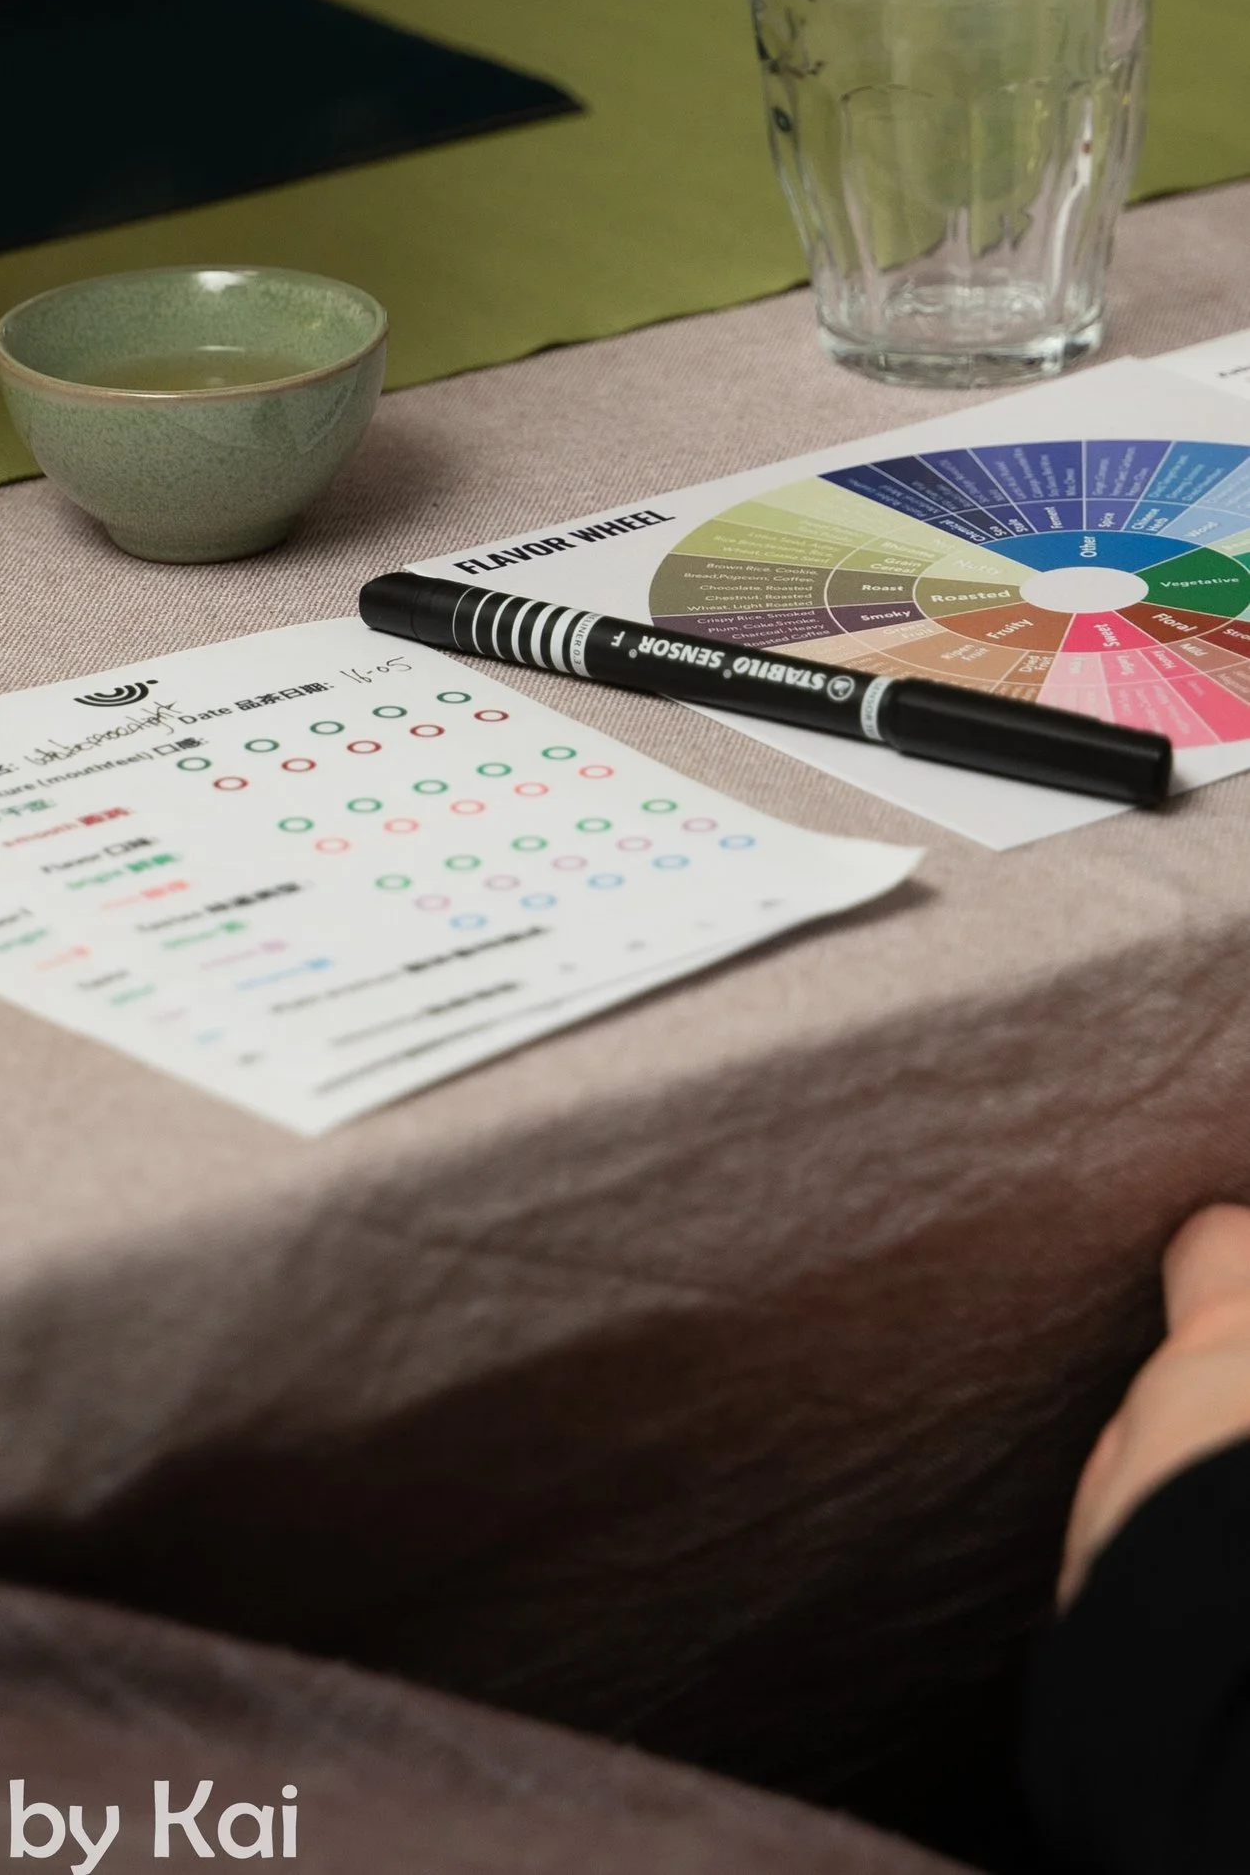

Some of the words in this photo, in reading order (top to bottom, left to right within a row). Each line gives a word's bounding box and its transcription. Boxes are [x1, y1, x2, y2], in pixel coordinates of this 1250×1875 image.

[452, 536, 578, 575] FLAVOR
[567, 509, 676, 543] WHEEL
[1079, 536, 1097, 558] Other
[706, 563, 743, 571] Brown
[870, 563, 916, 574] Cereal
[884, 557, 923, 568] Grain
[765, 584, 813, 592] Roasted
[861, 584, 905, 592] Roast
[1159, 576, 1240, 588] Vegetative
[930, 589, 1011, 603] Roasted
[733, 602, 764, 611] Light
[766, 600, 813, 608] Roasted
[697, 616, 734, 625] Crispy
[767, 610, 816, 619] Smoked
[860, 609, 912, 622] Smoky
[1152, 613, 1199, 633] Floral
[791, 629, 831, 641] Coffee
[985, 617, 1034, 640] Fruity
[1093, 622, 1121, 648] Sweet
[1222, 628, 1250, 641] Stro
[610, 630, 626, 647] F
[638, 635, 726, 669] SENSOR
[1179, 643, 1208, 658] Mild
[732, 656, 828, 691] STABILO
[177, 705, 234, 725] Date
[234, 681, 336, 711] 品茶日期:
[37, 751, 155, 789] (mouthfeel)
